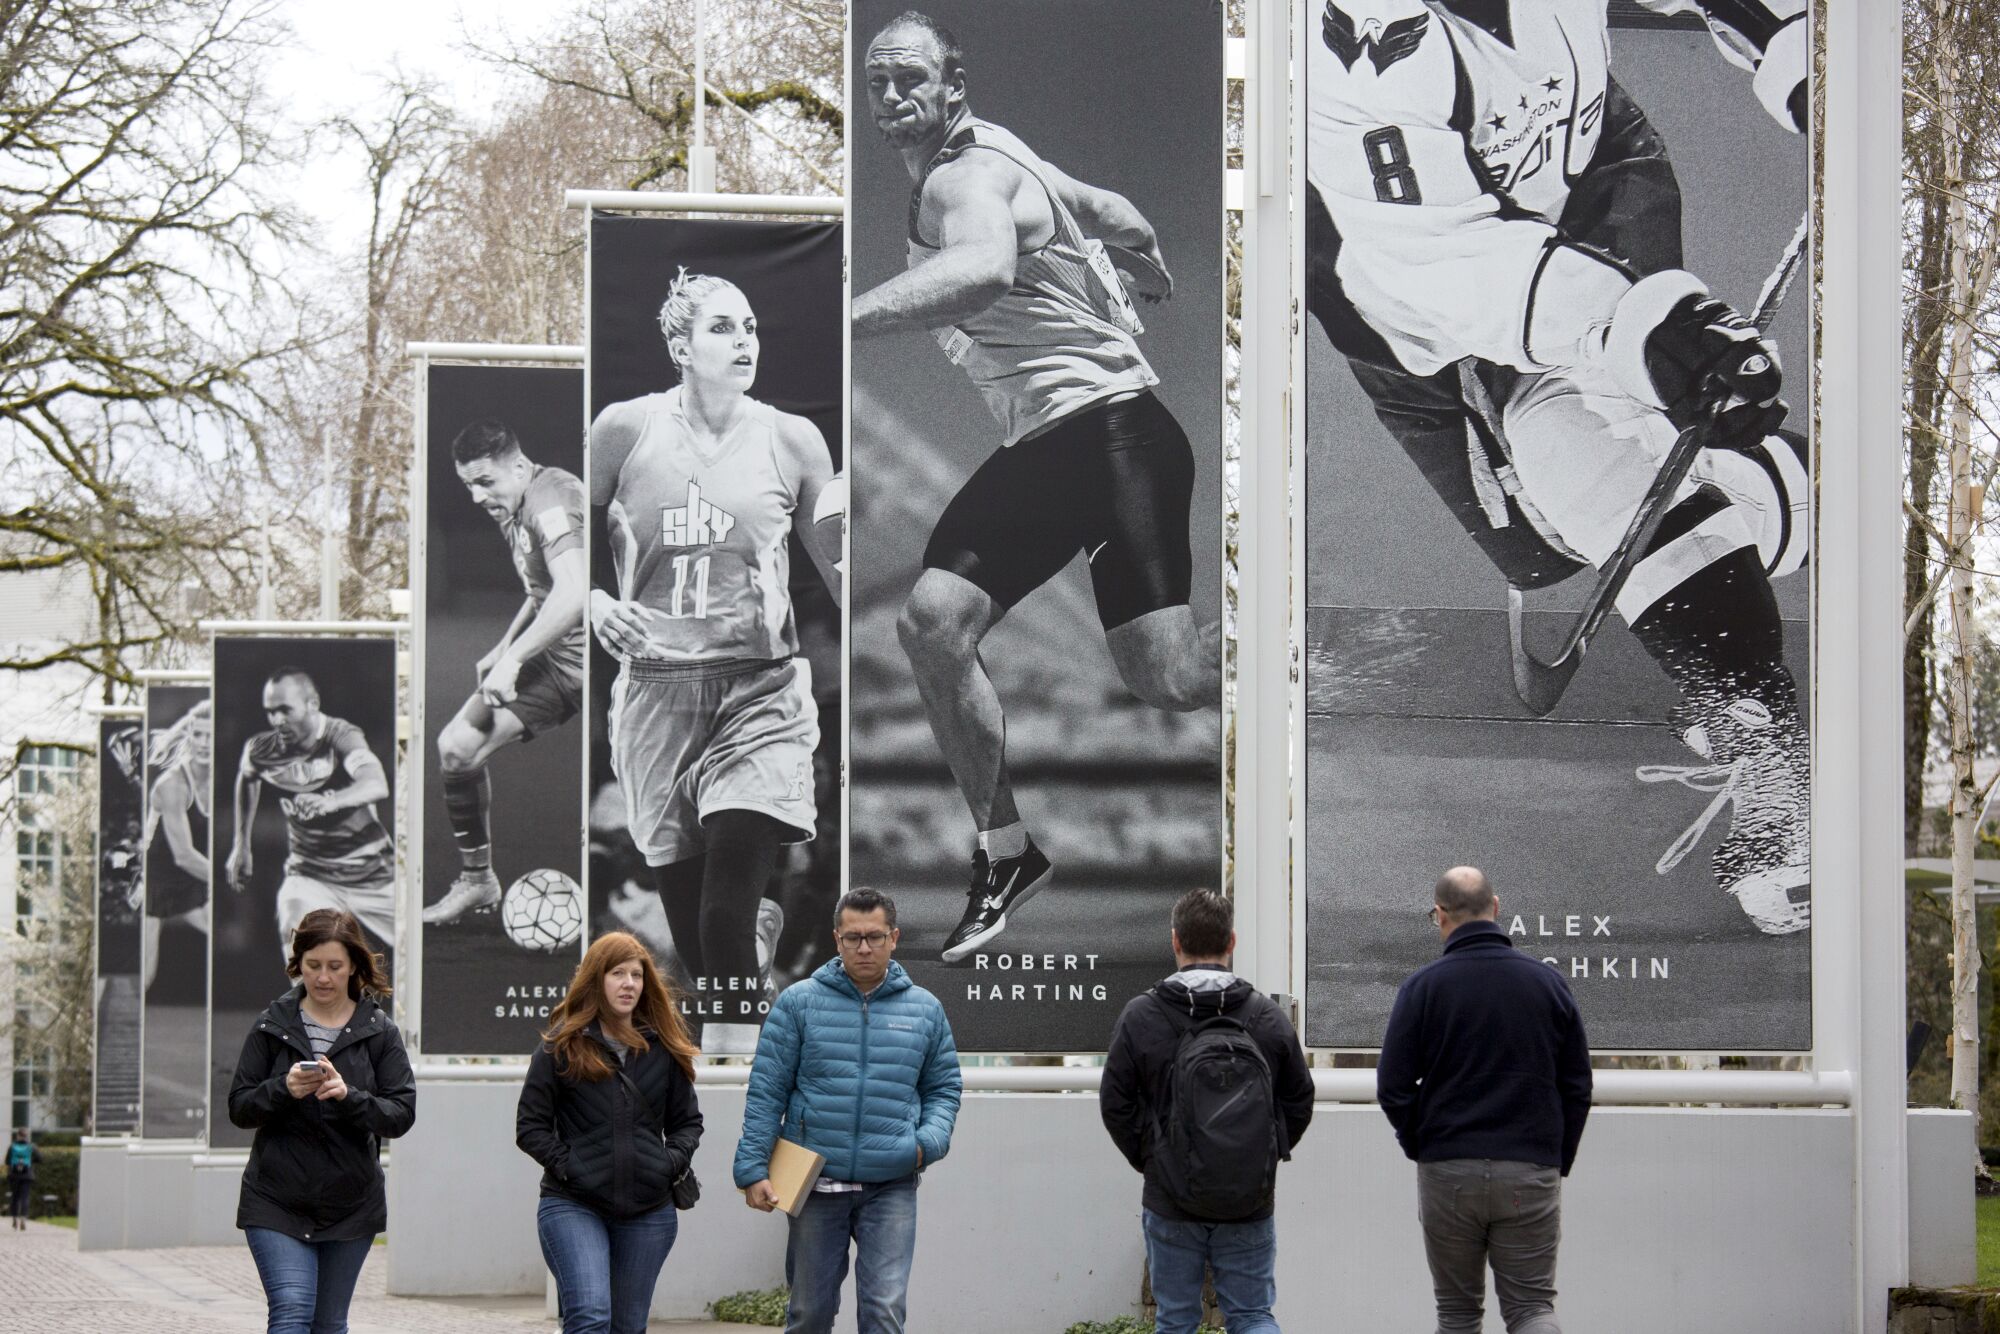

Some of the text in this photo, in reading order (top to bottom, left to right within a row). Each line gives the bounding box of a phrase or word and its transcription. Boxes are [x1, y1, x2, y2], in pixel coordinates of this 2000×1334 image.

[1362, 124, 1422, 205] 8
[672, 555, 711, 620] 11
[1509, 914, 1611, 936] ALEX
[975, 954, 1099, 970] ROBERT
[1542, 956, 1669, 979] HKIN
[697, 976, 775, 991] ELENA
[506, 986, 566, 998] ALEXI
[967, 984, 1107, 1001] HARTING
[495, 1003, 549, 1018] SÁNC
[681, 1001, 770, 1014] LLE DO
